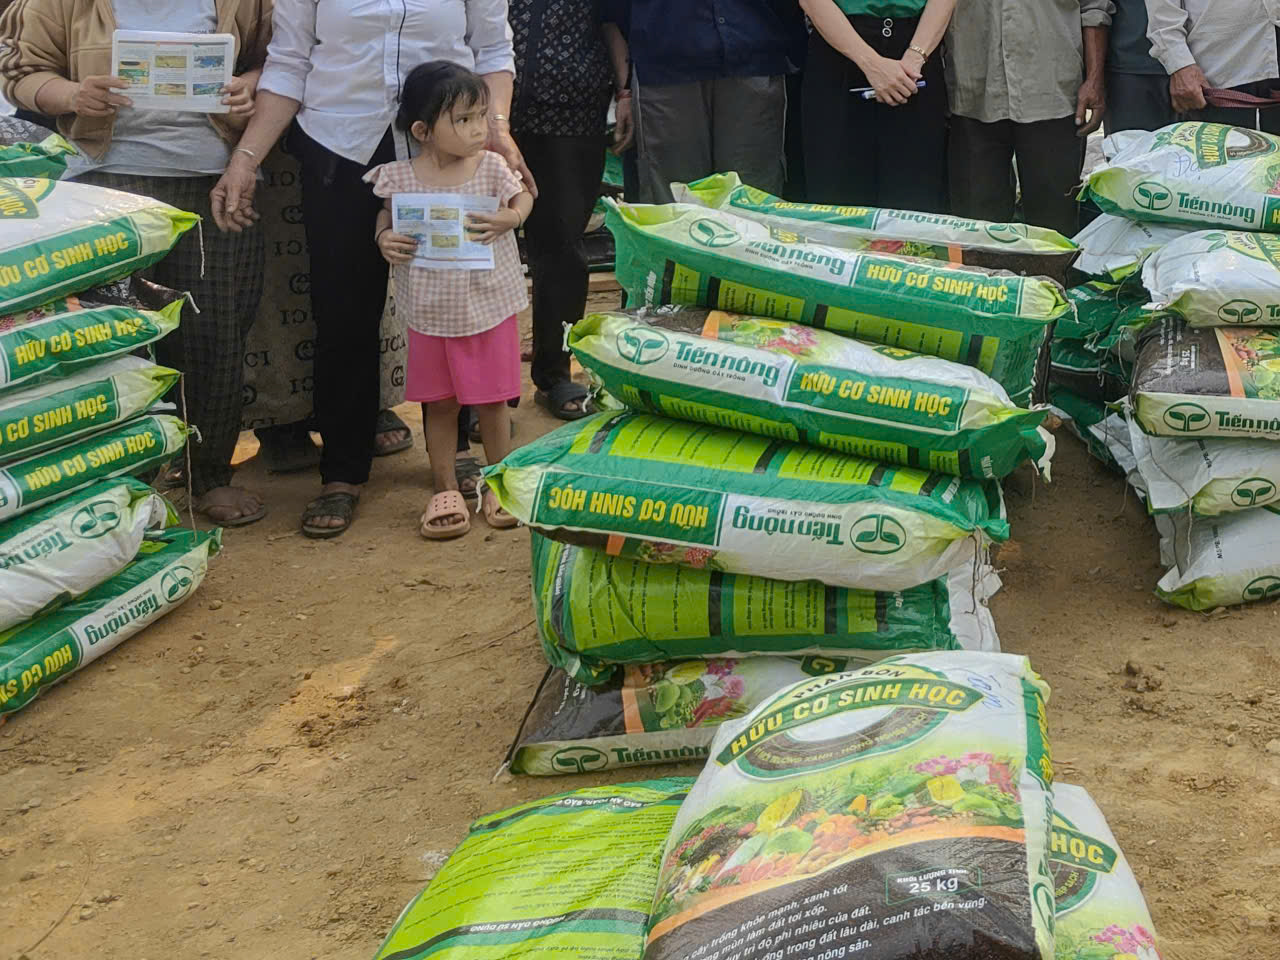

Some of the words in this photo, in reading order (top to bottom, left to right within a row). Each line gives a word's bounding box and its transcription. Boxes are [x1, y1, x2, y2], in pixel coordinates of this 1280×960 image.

[1177, 192, 1210, 210] Tiến
[1211, 202, 1256, 224] nông
[24, 254, 50, 278] CƠ
[51, 242, 94, 269] SINH
[94, 232, 129, 256] HỌC
[789, 245, 846, 276] nông
[866, 263, 903, 284] HỮU
[906, 271, 929, 289] CƠ
[932, 277, 975, 297] SINH
[976, 284, 1009, 304] HỌC
[15, 338, 47, 365] HỮU
[50, 330, 72, 353] CƠ
[74, 322, 113, 347] SINH
[676, 341, 719, 367] Tiến
[719, 355, 781, 388] nông
[800, 370, 837, 395] HỮU
[838, 380, 867, 400] CƠ
[867, 385, 913, 409] SINH
[914, 391, 953, 417] HỌC
[6, 418, 29, 442] CƠ
[33, 405, 73, 433] SINH
[74, 394, 108, 420] HỌC
[1215, 411, 1259, 430] Tiến
[24, 466, 62, 491] HỮU
[62, 454, 87, 477] CƠ
[86, 441, 126, 468] SINH
[125, 431, 157, 454] HỌC
[548, 483, 588, 511] HỌC
[589, 492, 637, 519] SINH
[638, 498, 667, 523] CƠ
[669, 502, 710, 530] HỮU
[732, 505, 796, 536] nông
[23, 531, 74, 561] Tiến
[796, 520, 845, 546] Tiến
[129, 593, 164, 625] Tiến
[83, 609, 131, 646] nông
[44, 644, 73, 676] HỮU
[21, 663, 43, 693] CƠ
[731, 711, 784, 756] HỮU
[793, 692, 830, 720] CƠ
[837, 682, 903, 708] SINH
[908, 682, 967, 707] HỌC
[611, 746, 661, 763] Tiến
[663, 744, 711, 760] nôn
[1051, 832, 1105, 864] HỌC
[909, 881, 932, 894] 25
[936, 877, 959, 892] kg
[711, 929, 739, 948] trồng
[803, 890, 831, 906] xanh
[832, 884, 849, 897] tốt
[721, 937, 745, 955] mùn
[747, 928, 766, 941] làm
[767, 918, 786, 933] đất
[805, 902, 829, 919] xốp.
[757, 936, 773, 951] độ
[794, 919, 827, 936] nhiêu
[827, 911, 849, 926] của
[850, 905, 873, 921] đất.
[786, 938, 817, 956] trong
[818, 931, 838, 946] đất
[839, 926, 858, 939] lâu
[859, 918, 881, 934] dài,
[882, 911, 911, 927] canh
[912, 904, 932, 919] tác
[932, 899, 956, 912] bền
[848, 937, 873, 954] sản.
